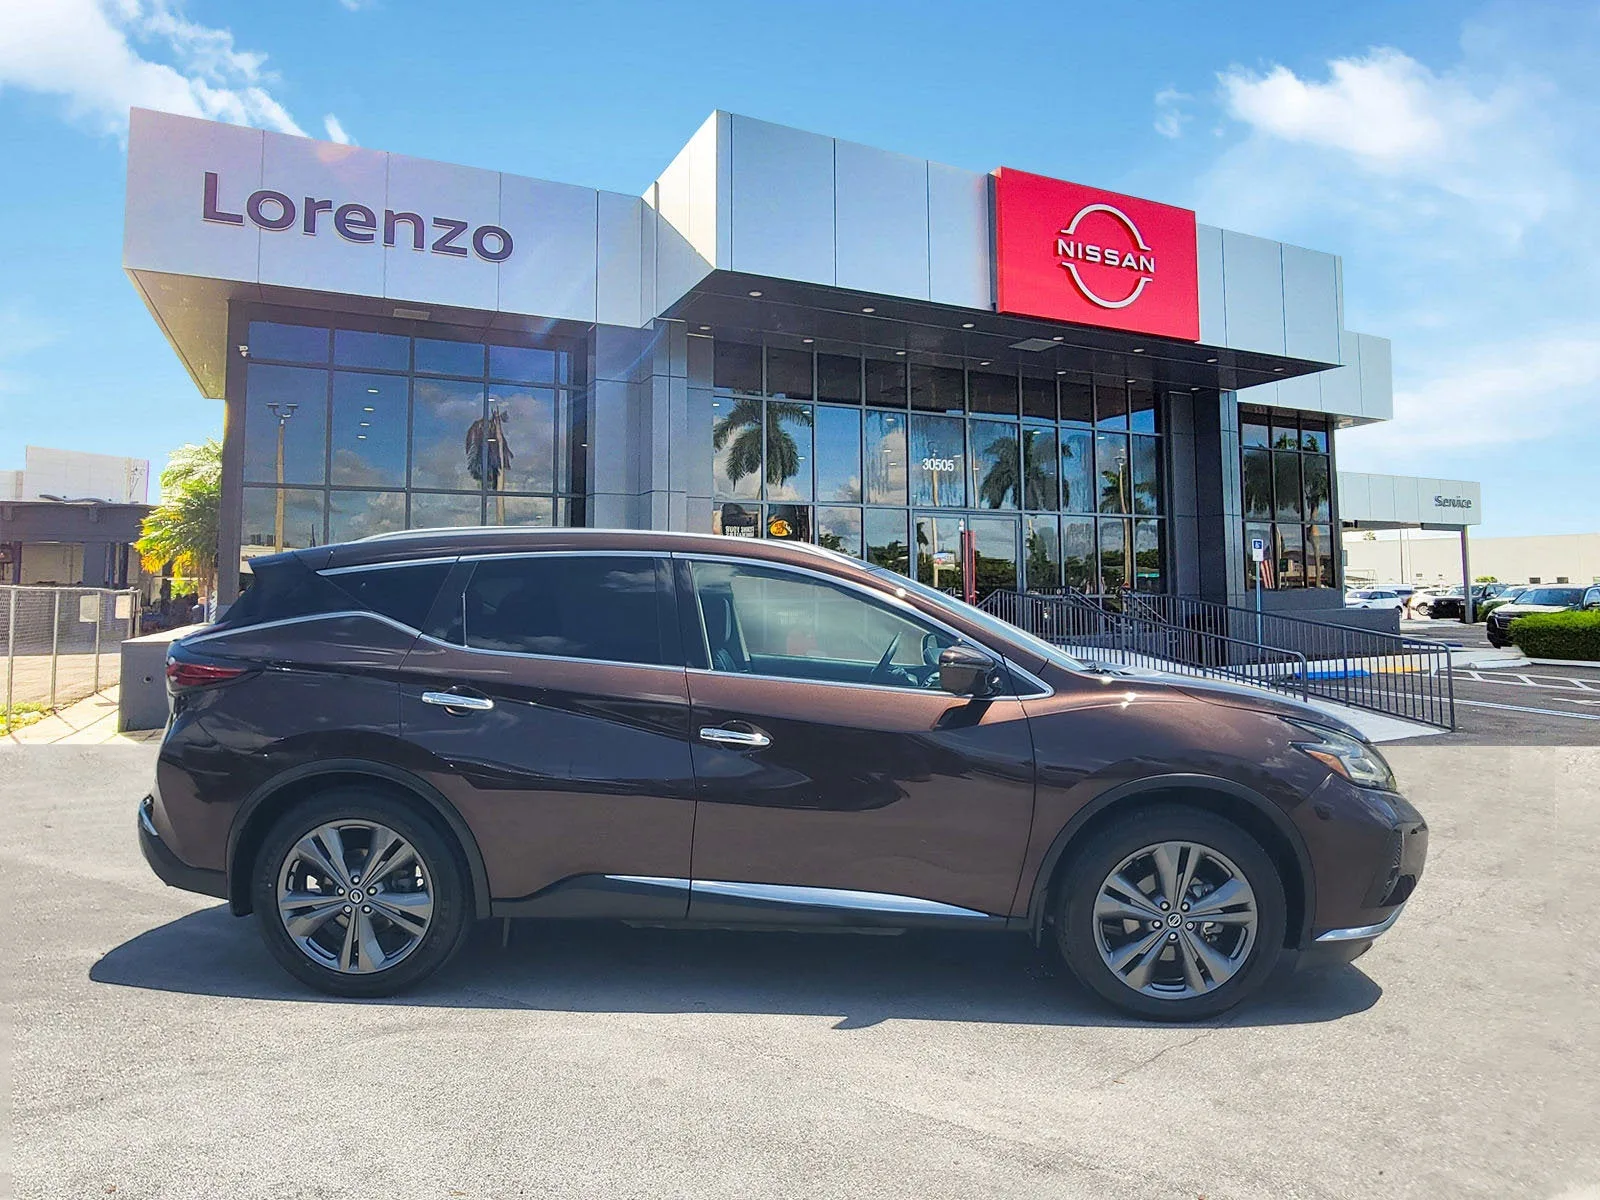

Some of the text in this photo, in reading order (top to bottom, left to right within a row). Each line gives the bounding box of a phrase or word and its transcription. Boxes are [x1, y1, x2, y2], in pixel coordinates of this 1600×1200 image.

[203, 171, 514, 262] Lorenzo
[1057, 238, 1155, 273] NISSAN
[922, 458, 955, 472] 30505
[1434, 495, 1472, 509] Service
